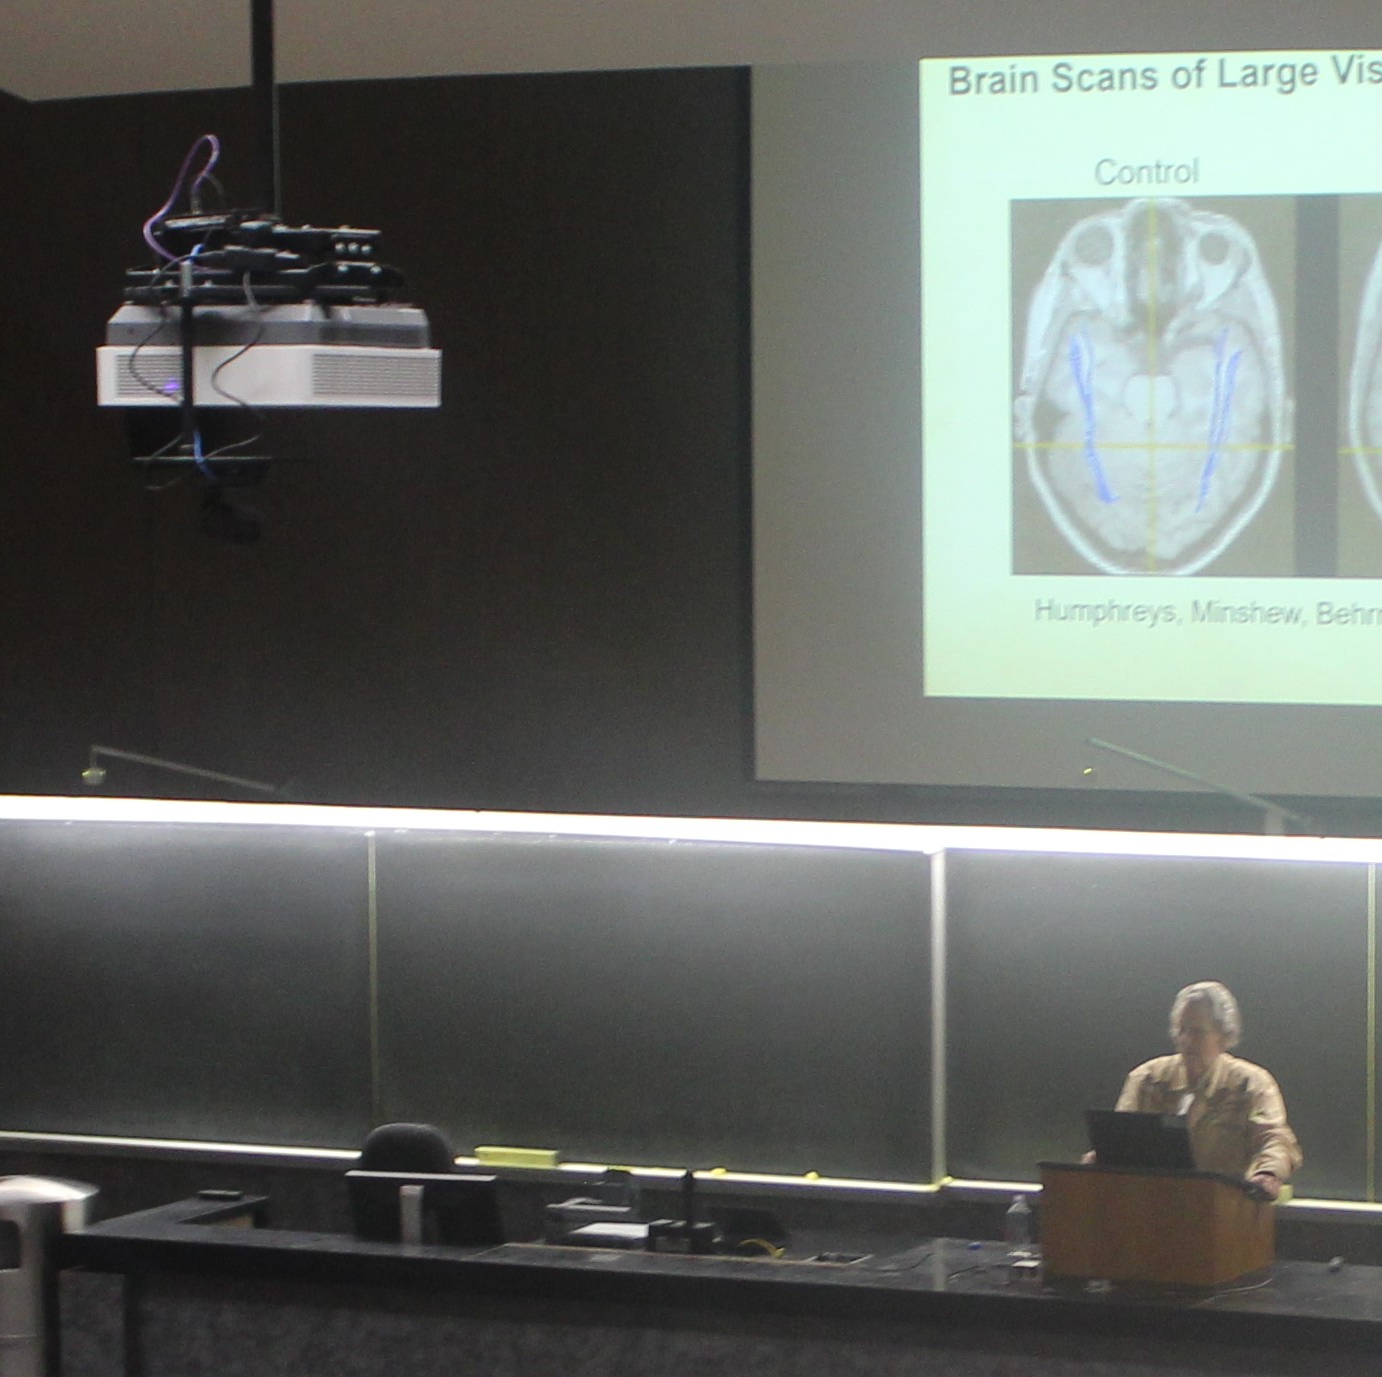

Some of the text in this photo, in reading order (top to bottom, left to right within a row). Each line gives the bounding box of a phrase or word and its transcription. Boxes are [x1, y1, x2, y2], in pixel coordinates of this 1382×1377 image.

[948, 65, 1039, 96] Brain
[1051, 62, 1158, 92] Scans
[1171, 58, 1207, 89] of
[1218, 57, 1319, 95] Large
[1094, 157, 1201, 186] Control
[1035, 598, 1183, 628] Humphreys,
[1190, 599, 1308, 628] Minshew,
